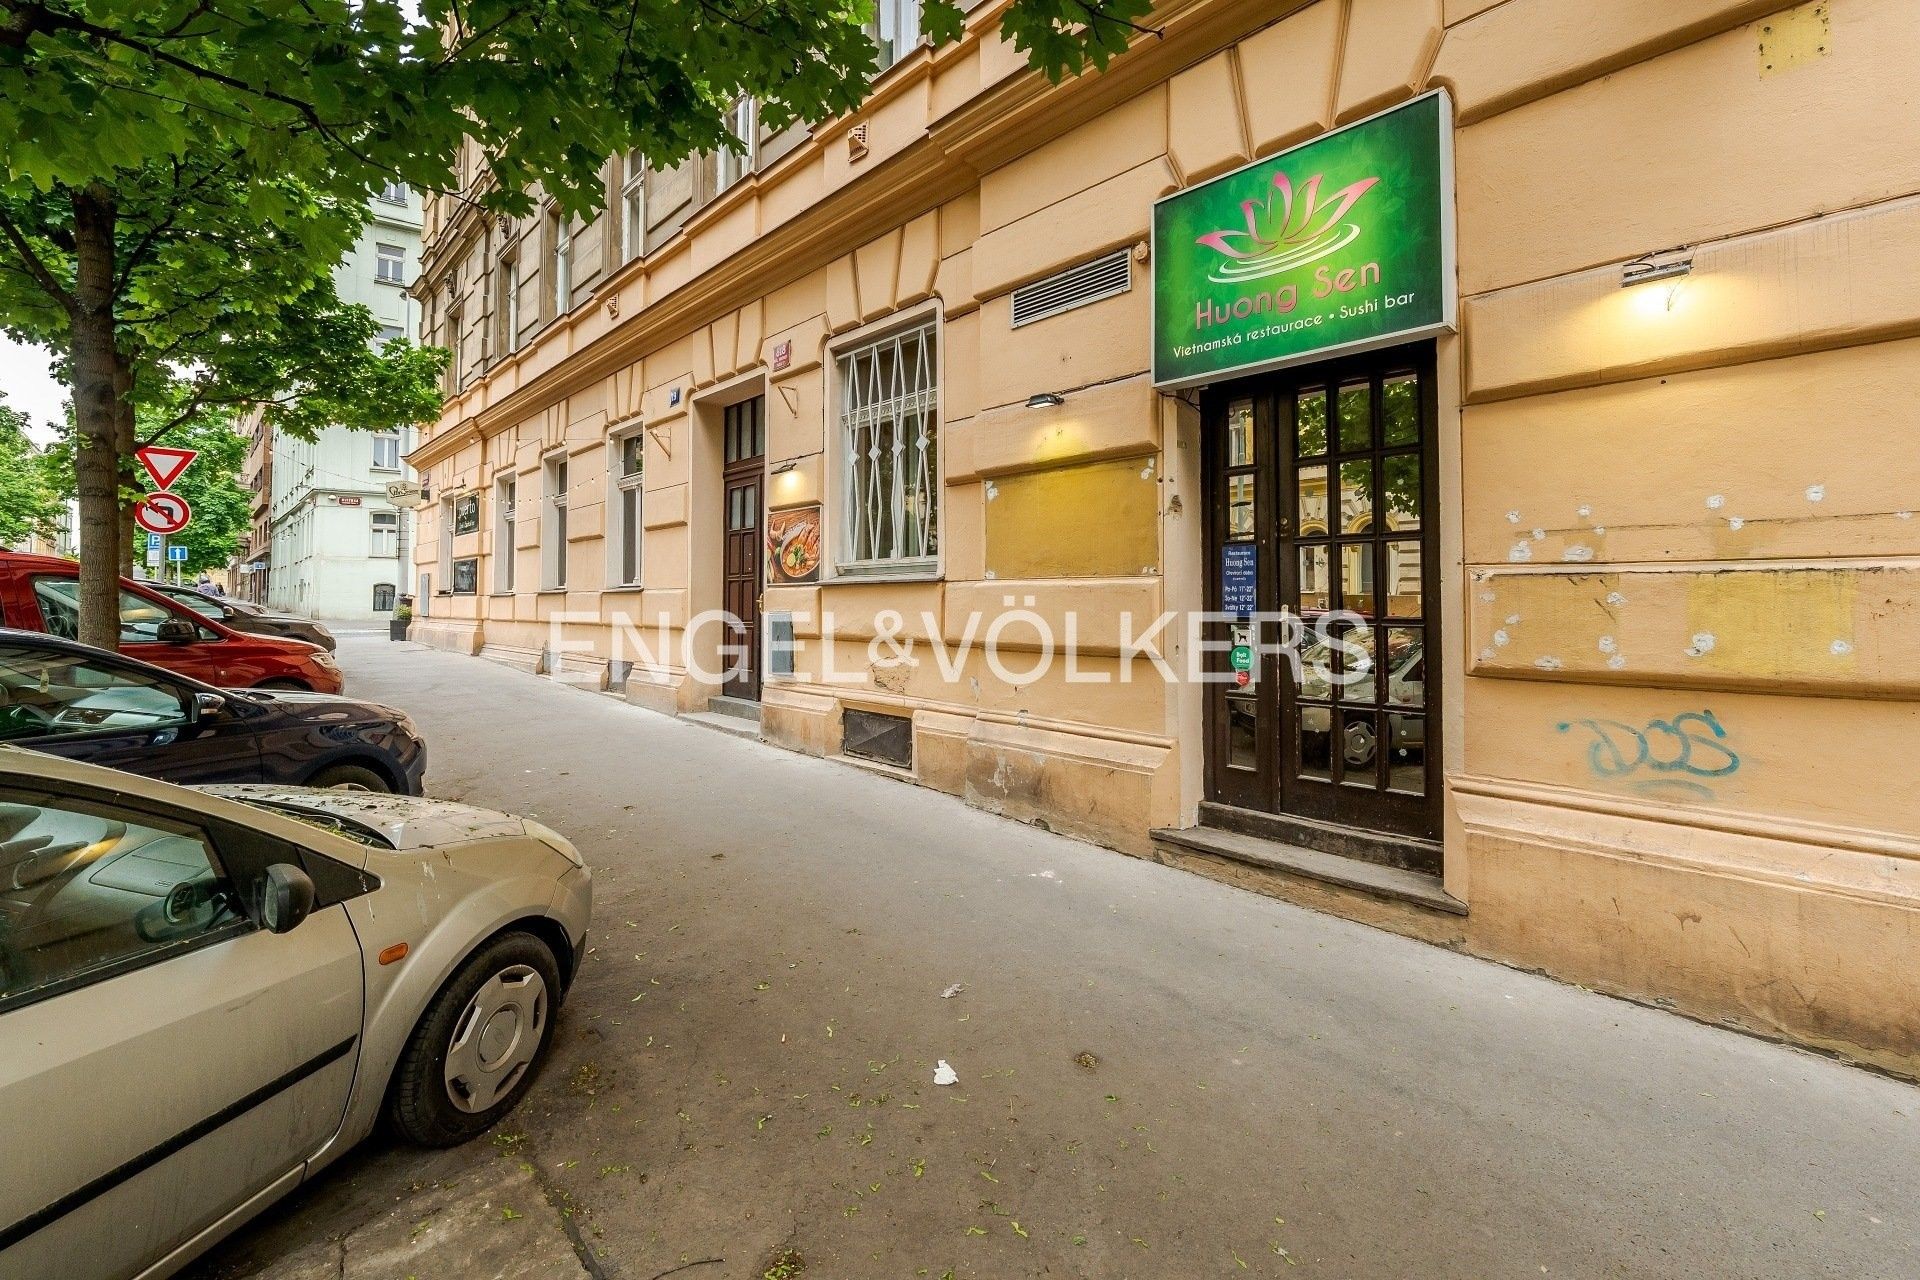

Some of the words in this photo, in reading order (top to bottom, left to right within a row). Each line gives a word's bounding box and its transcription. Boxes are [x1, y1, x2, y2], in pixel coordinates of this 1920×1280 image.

[1195, 284, 1297, 330] Huong
[1313, 262, 1380, 299] Sen
[1173, 333, 1242, 359] Vietnamská
[1247, 314, 1323, 342] restaurace
[1339, 298, 1379, 320] Sushi
[1384, 291, 1416, 310] bar
[151, 535, 160, 545] P
[1225, 558, 1243, 568] Huong
[1243, 557, 1254, 566] Sen
